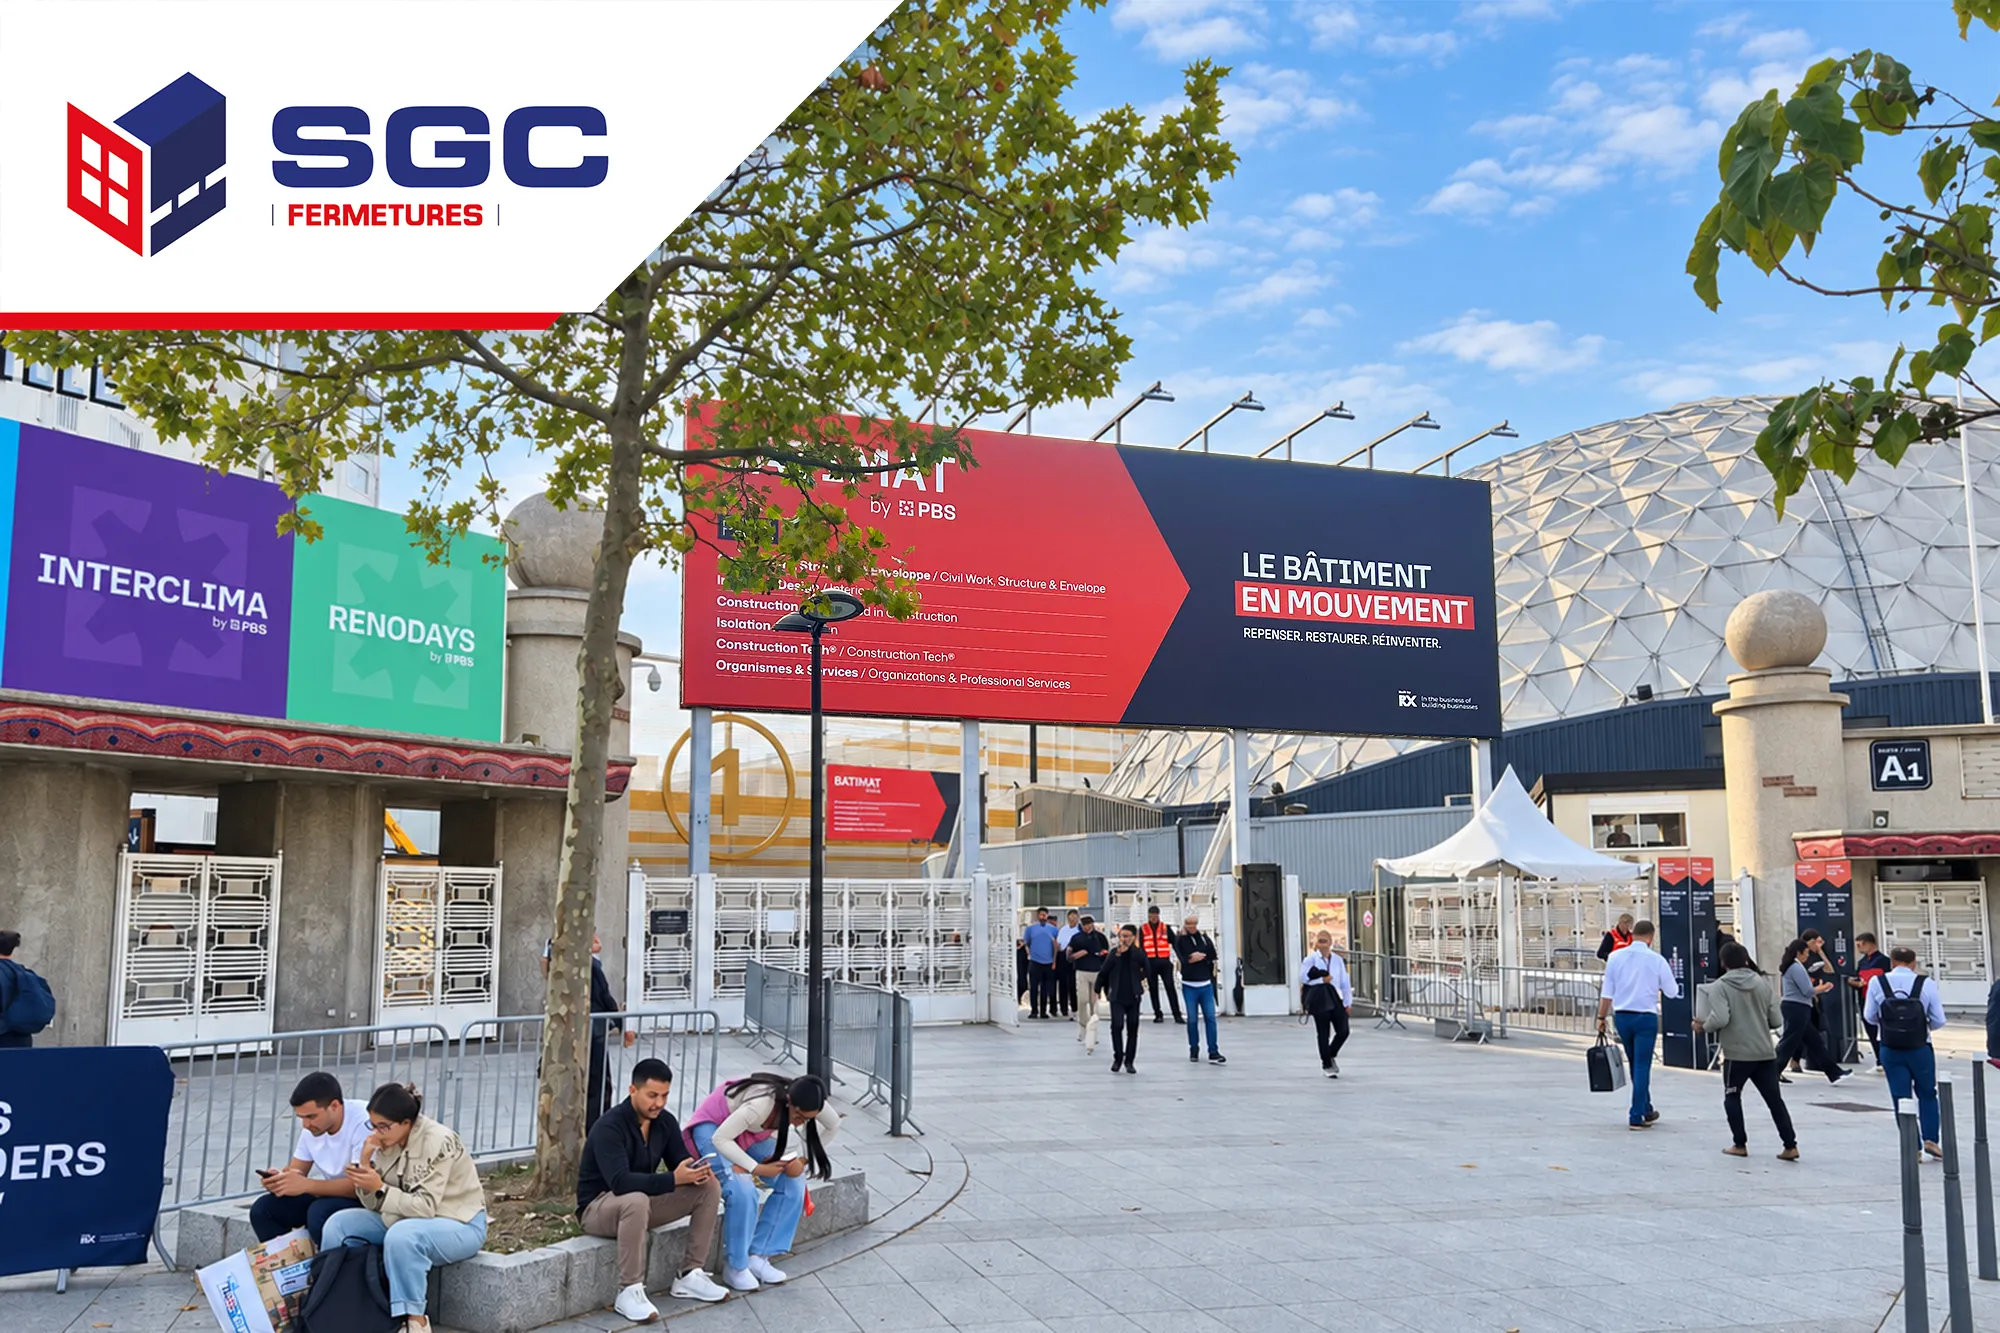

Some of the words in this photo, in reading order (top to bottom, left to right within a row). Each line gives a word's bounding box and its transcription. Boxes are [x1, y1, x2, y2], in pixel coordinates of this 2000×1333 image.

[870, 497, 892, 519] by
[918, 502, 957, 521] PBS
[1243, 552, 1277, 579] LE
[1284, 550, 1432, 589] BÂTIMENT
[37, 553, 268, 620] INTERCLIMA
[940, 571, 963, 583] Civil
[965, 573, 996, 587] Work,
[998, 576, 1047, 589] Structure
[1049, 580, 1057, 590] &
[1060, 581, 1106, 594] Envelope
[716, 595, 799, 612] Construction
[873, 607, 884, 617] in
[1242, 586, 1280, 614] EN
[1288, 590, 1469, 625] MOUVEMENT
[212, 616, 228, 631] by
[241, 621, 268, 635] PBS
[329, 604, 476, 653] RENODAYS
[716, 616, 771, 631] Isolation
[716, 638, 799, 654] Construction
[839, 646, 845, 657] /
[846, 646, 920, 660] Construction
[1243, 627, 1304, 642] REPENSER.
[1305, 631, 1370, 646] RESTAURER.
[1372, 632, 1442, 649] RÉINVENTER.
[430, 651, 442, 665] by
[453, 654, 475, 668] PBS
[715, 659, 793, 674] Organismes
[794, 664, 805, 675] &
[860, 668, 867, 679] /
[868, 668, 946, 682] Organizations
[948, 672, 958, 683] &
[960, 673, 1025, 687] Professional
[1027, 677, 1071, 690] Services
[1880, 754, 1924, 782] A1
[833, 775, 882, 789] BATIMAT
